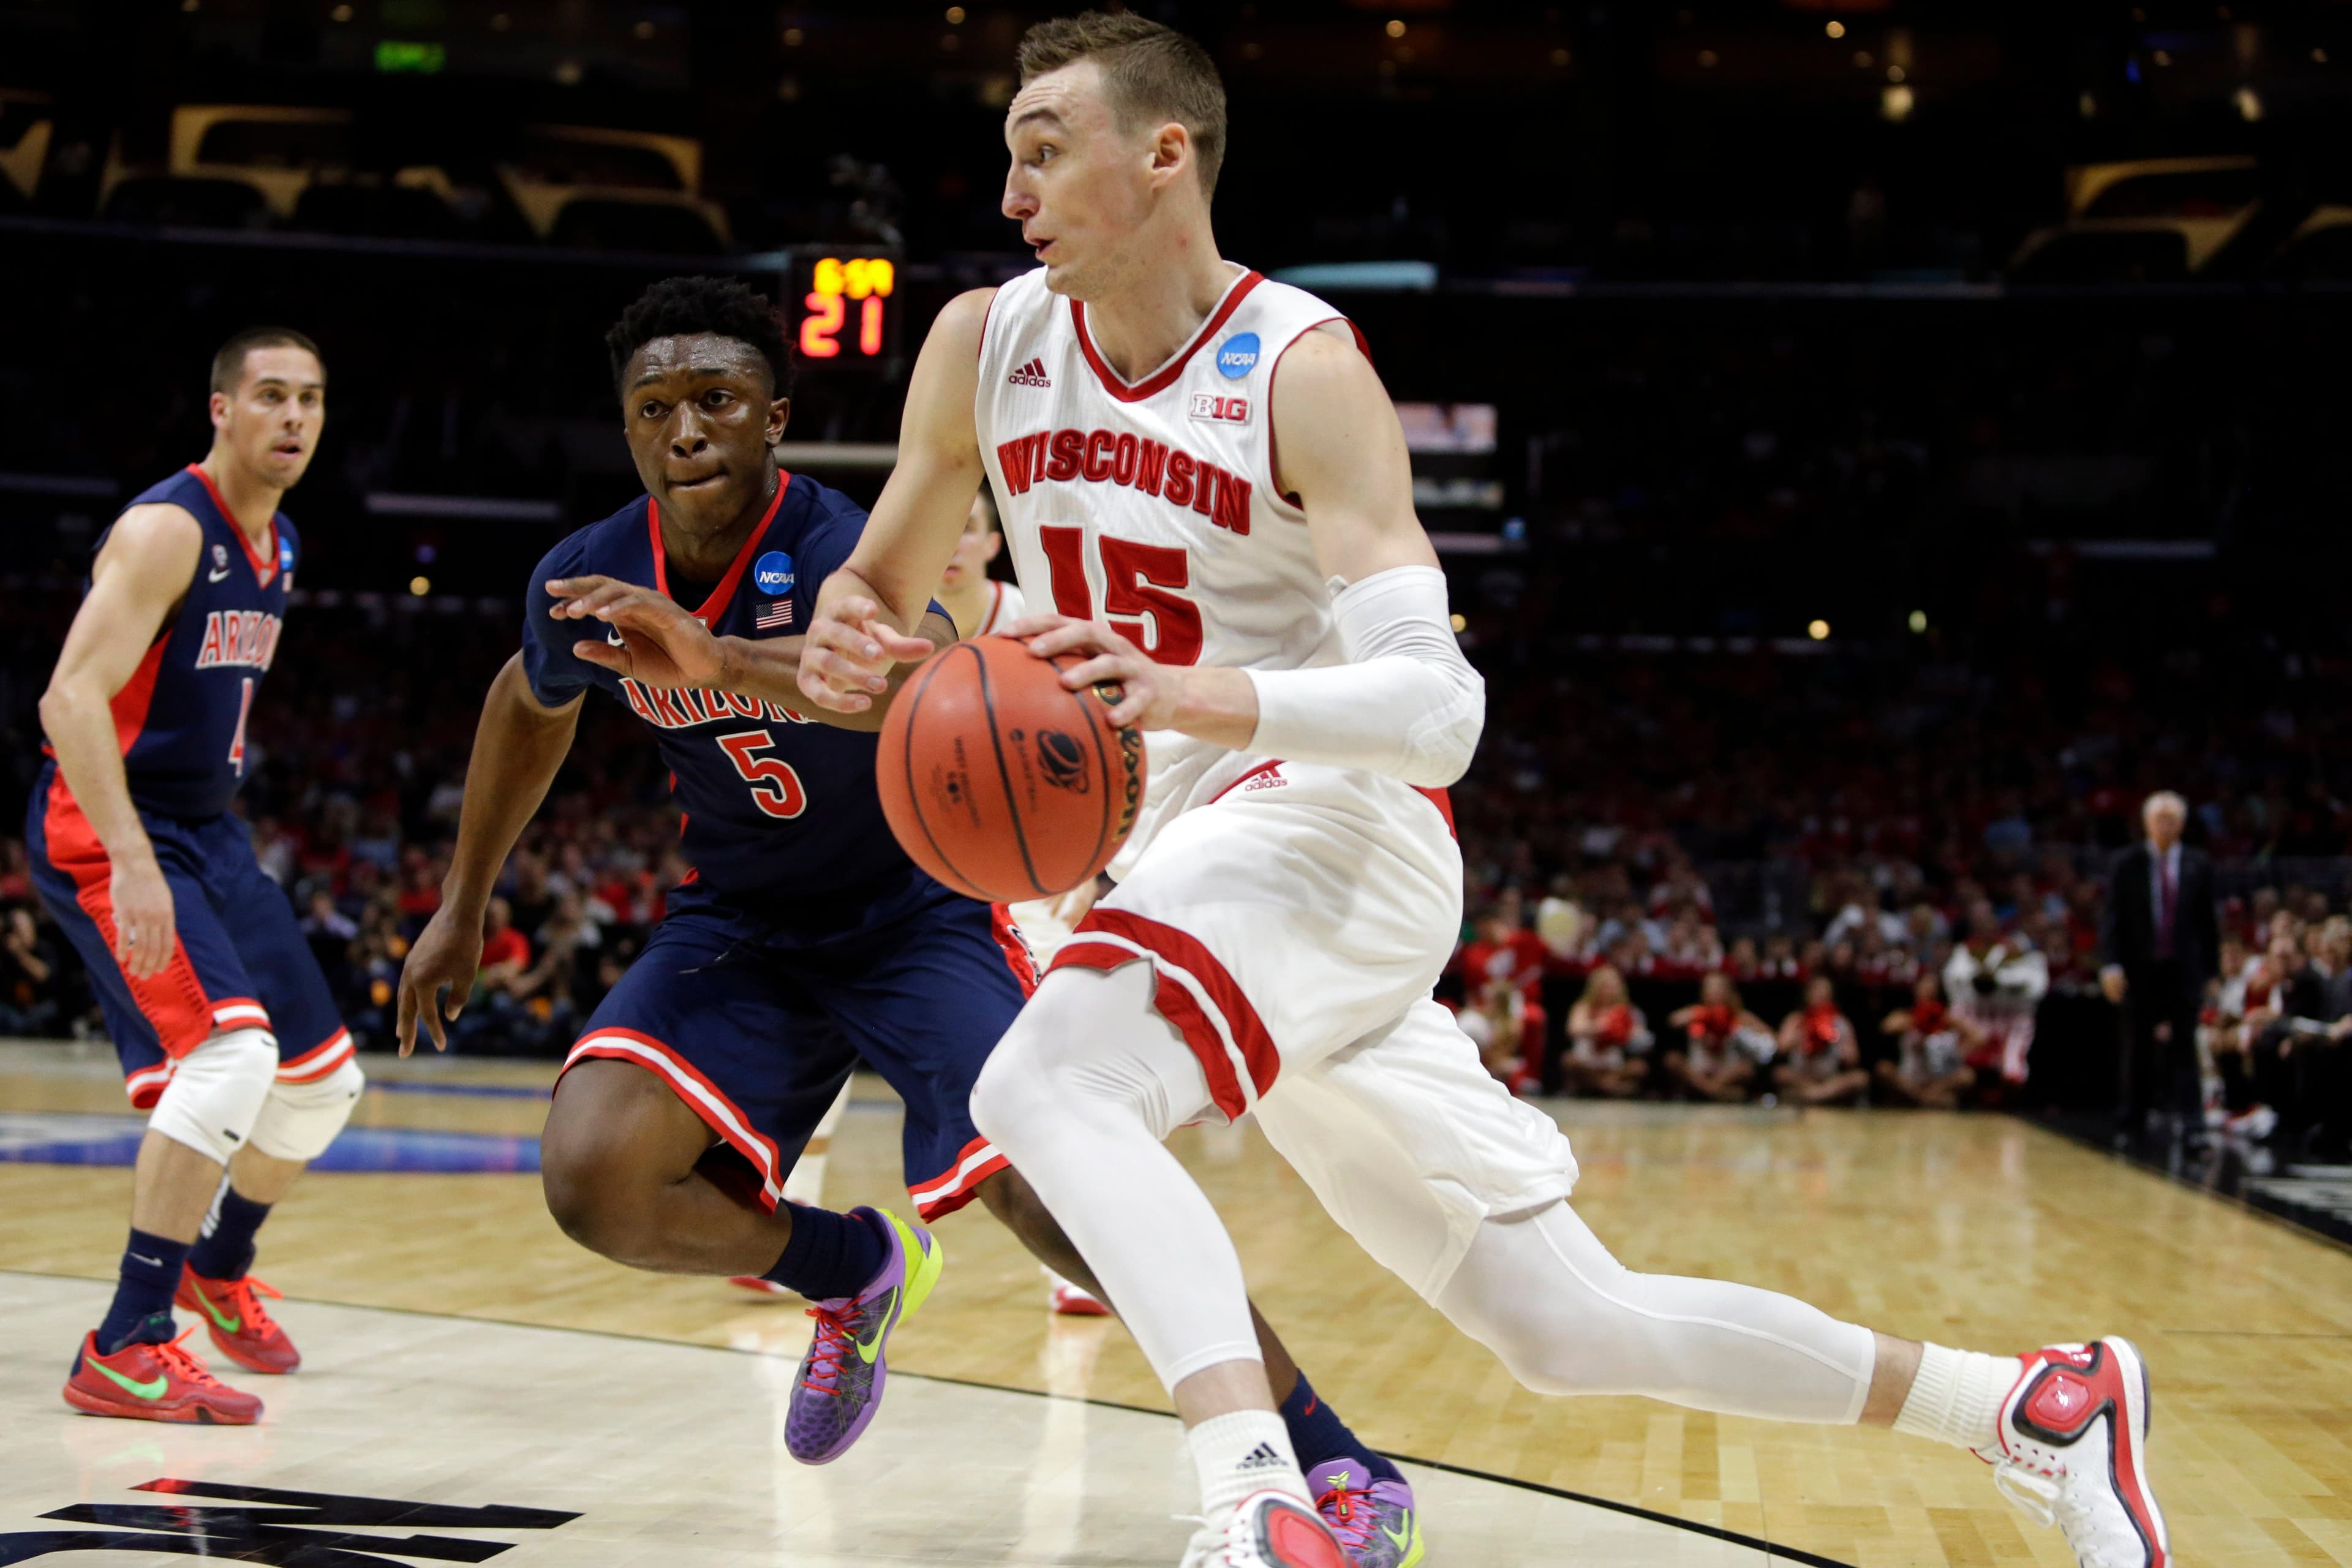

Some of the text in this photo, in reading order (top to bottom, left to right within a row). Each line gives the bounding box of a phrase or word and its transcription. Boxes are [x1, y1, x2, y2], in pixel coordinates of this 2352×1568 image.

[1009, 374, 1051, 388] adidas
[1221, 352, 1256, 366] NCAA
[997, 429, 1252, 535] WISCONSIN
[759, 571, 794, 584] NCAA
[1039, 524, 1204, 666] 15
[715, 729, 807, 819] 5
